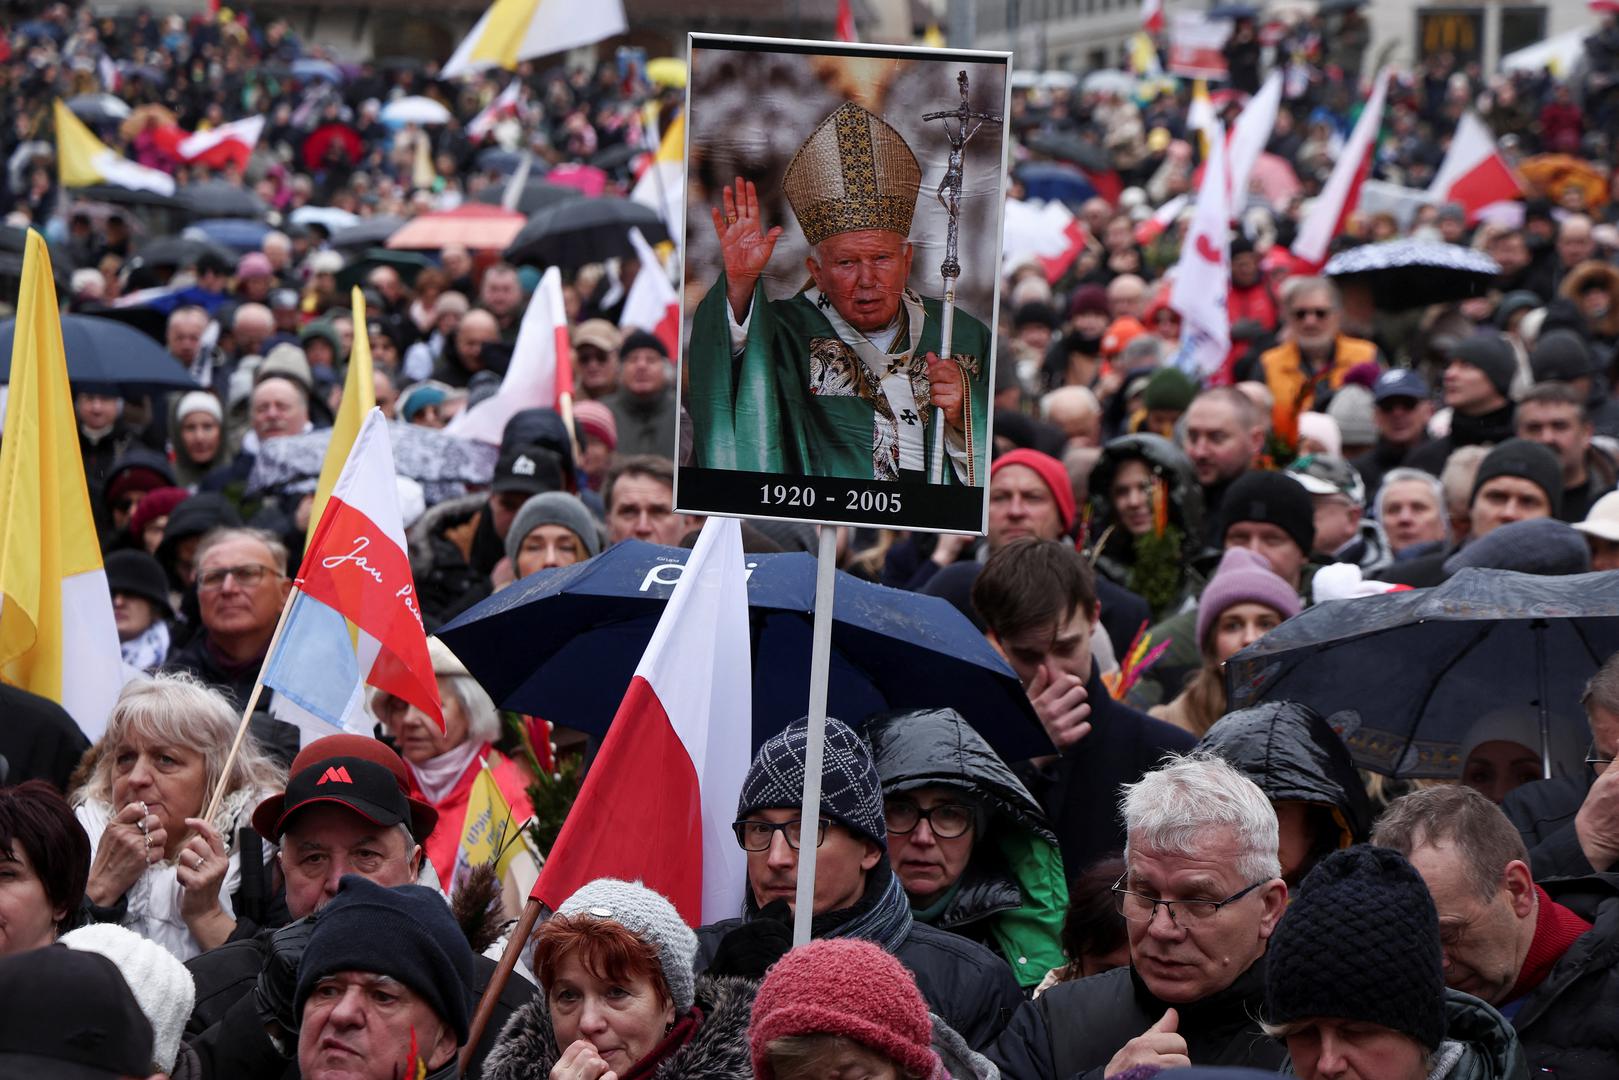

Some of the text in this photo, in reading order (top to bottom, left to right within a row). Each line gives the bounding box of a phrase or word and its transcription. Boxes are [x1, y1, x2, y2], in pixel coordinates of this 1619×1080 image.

[760, 484, 816, 507] 1920
[845, 489, 902, 513] 2005
[322, 536, 383, 583] Jan
